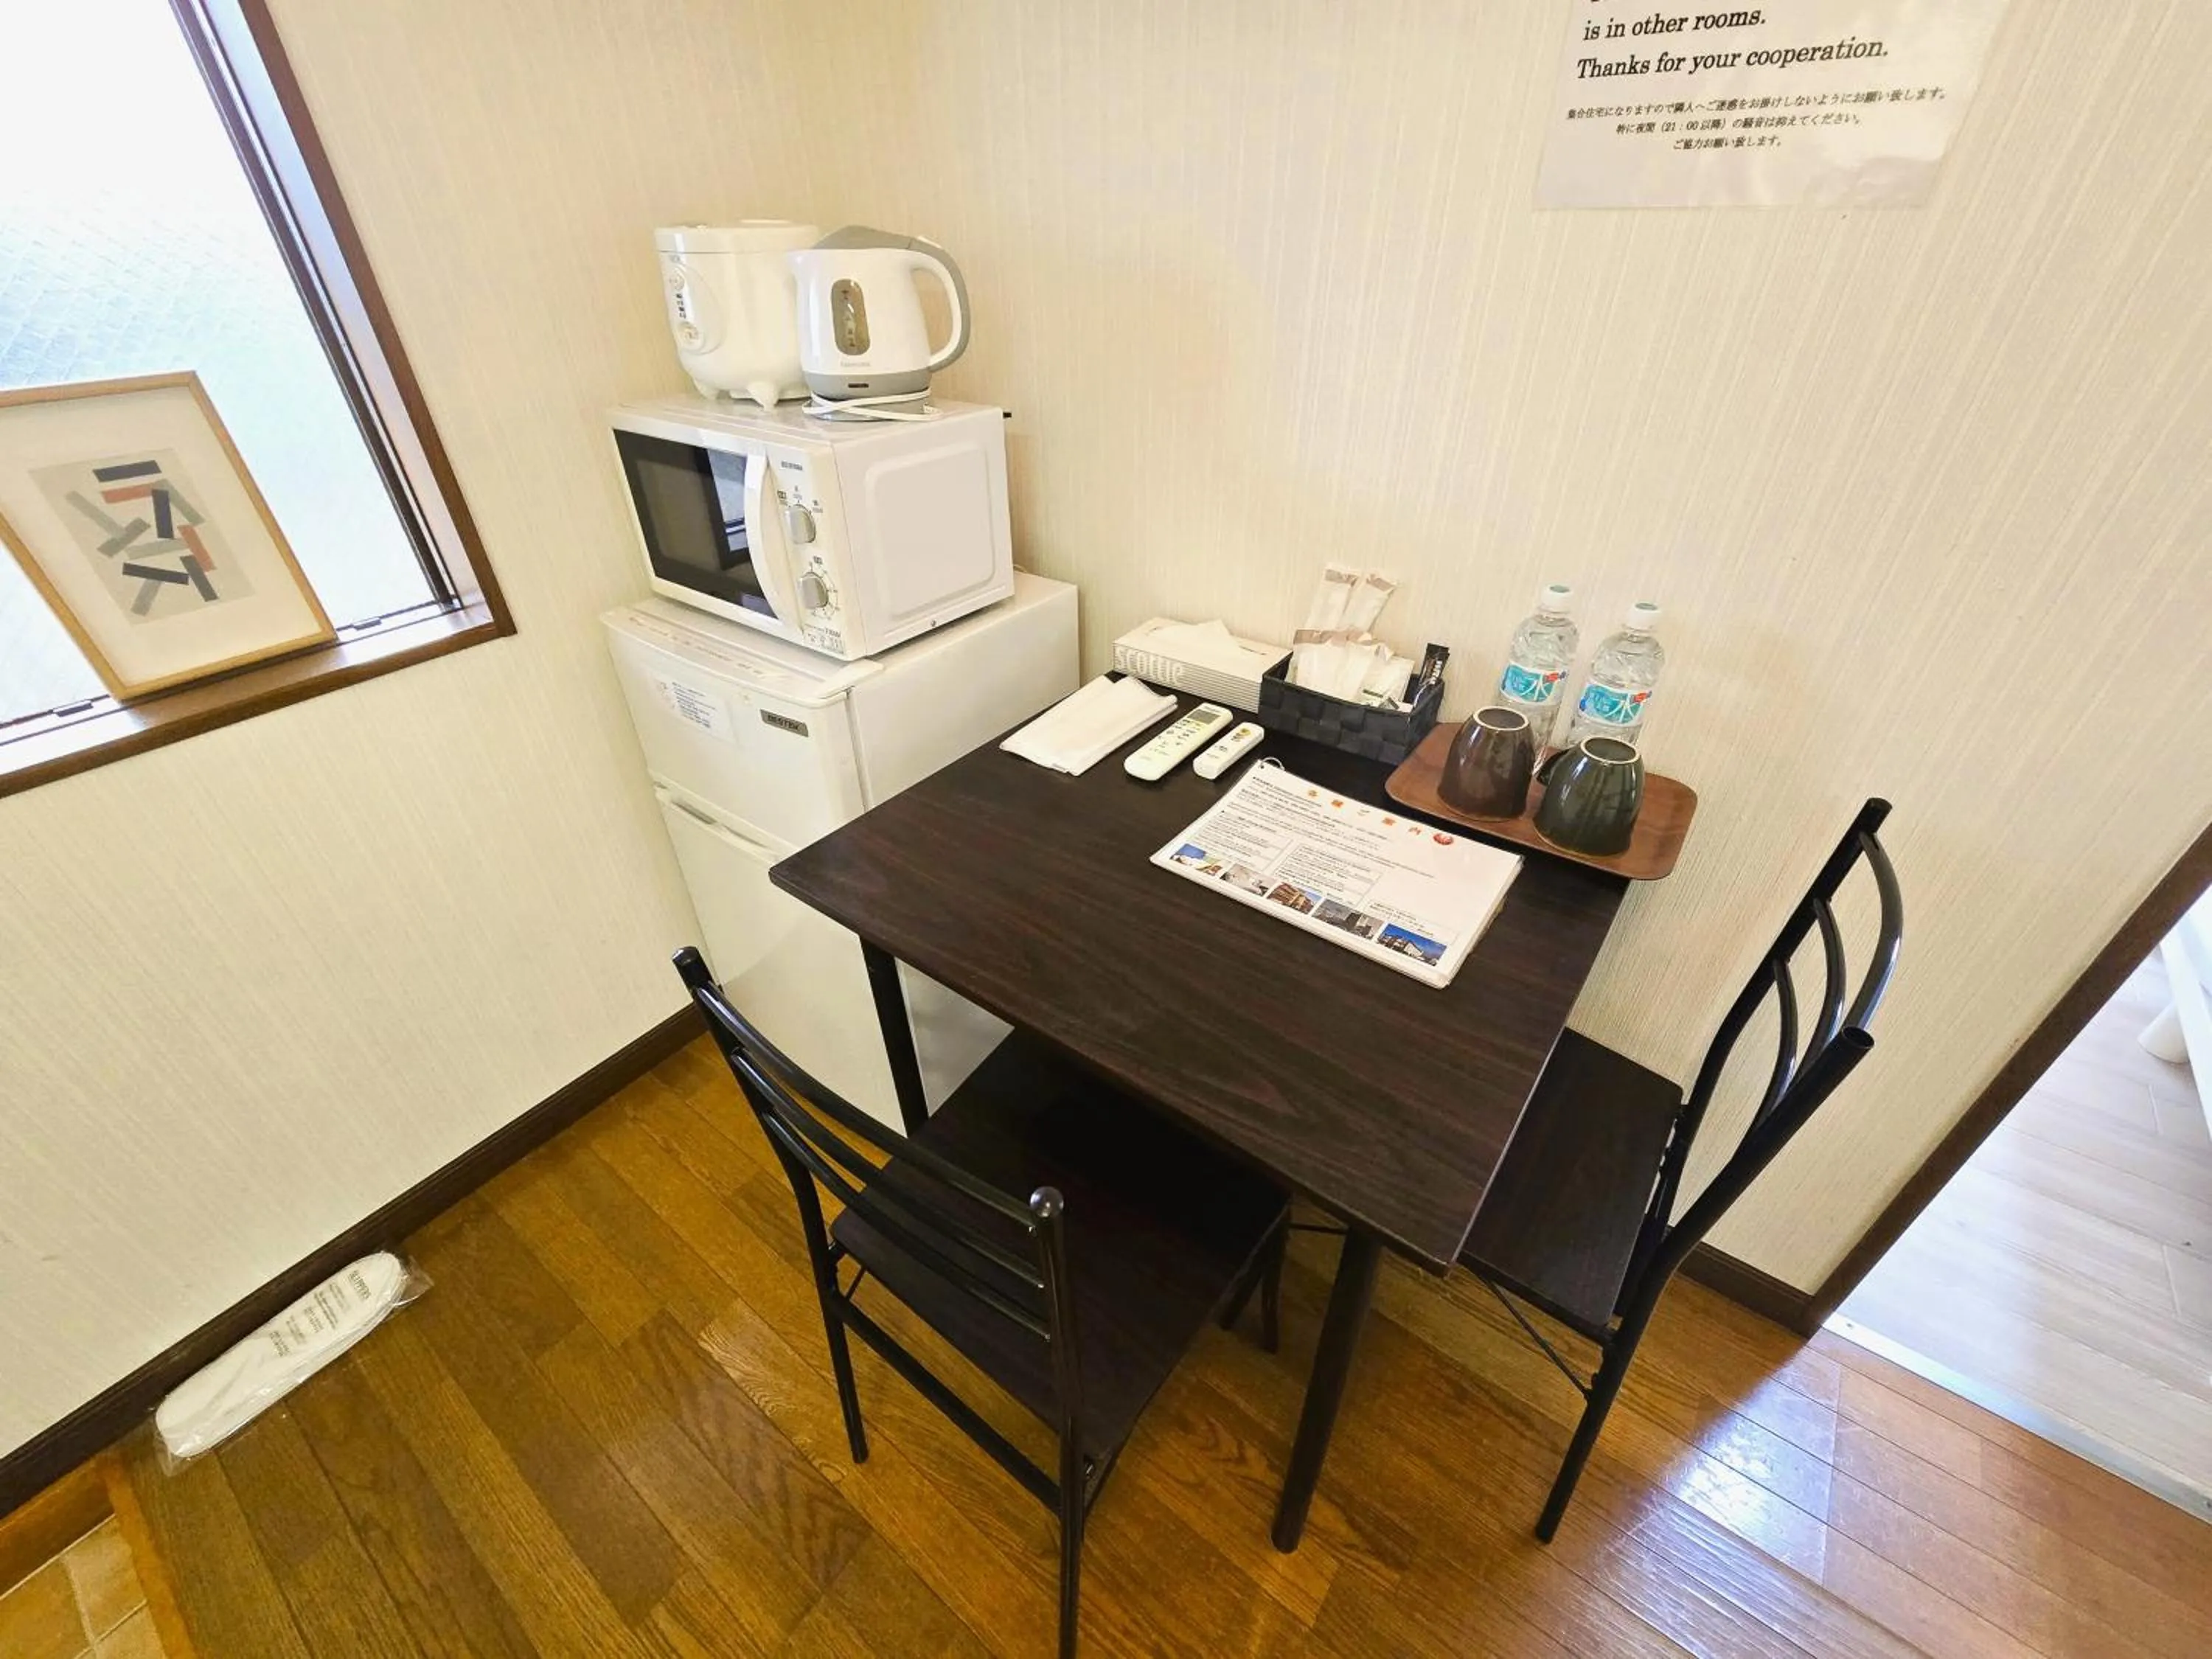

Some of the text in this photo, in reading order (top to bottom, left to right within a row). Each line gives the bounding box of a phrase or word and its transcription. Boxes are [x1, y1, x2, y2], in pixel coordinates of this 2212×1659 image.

[1583, 9, 1765, 41] is in other rooms.
[1577, 36, 1888, 79] Thanks for your cooperation.
